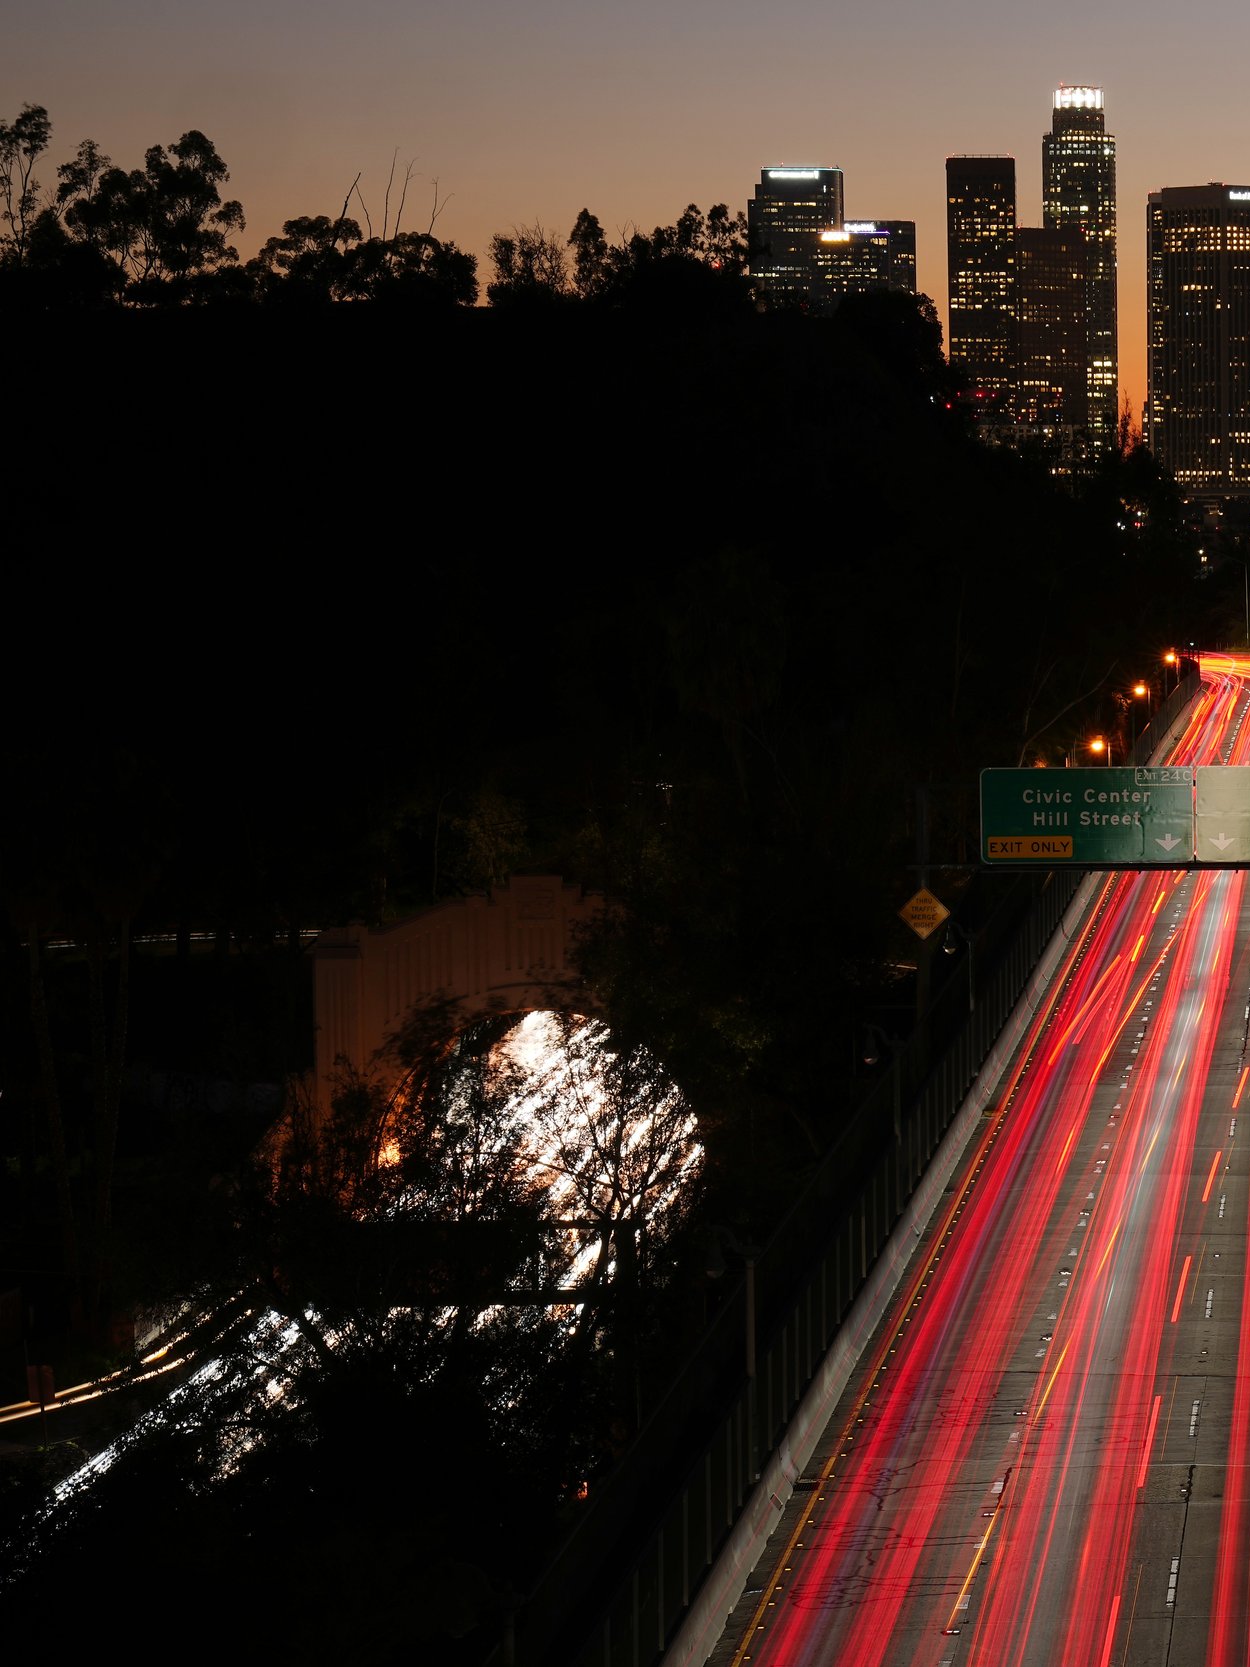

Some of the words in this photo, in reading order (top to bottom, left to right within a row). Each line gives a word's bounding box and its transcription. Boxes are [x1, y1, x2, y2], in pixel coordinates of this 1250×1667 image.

[1137, 771, 1158, 780] EXIT
[1022, 789, 1073, 804] Civic
[1083, 788, 1151, 803] Center
[1033, 811, 1069, 827] Hill
[1079, 811, 1141, 826] Street
[990, 841, 1023, 853] EXIT
[1031, 841, 1070, 853] ONLY
